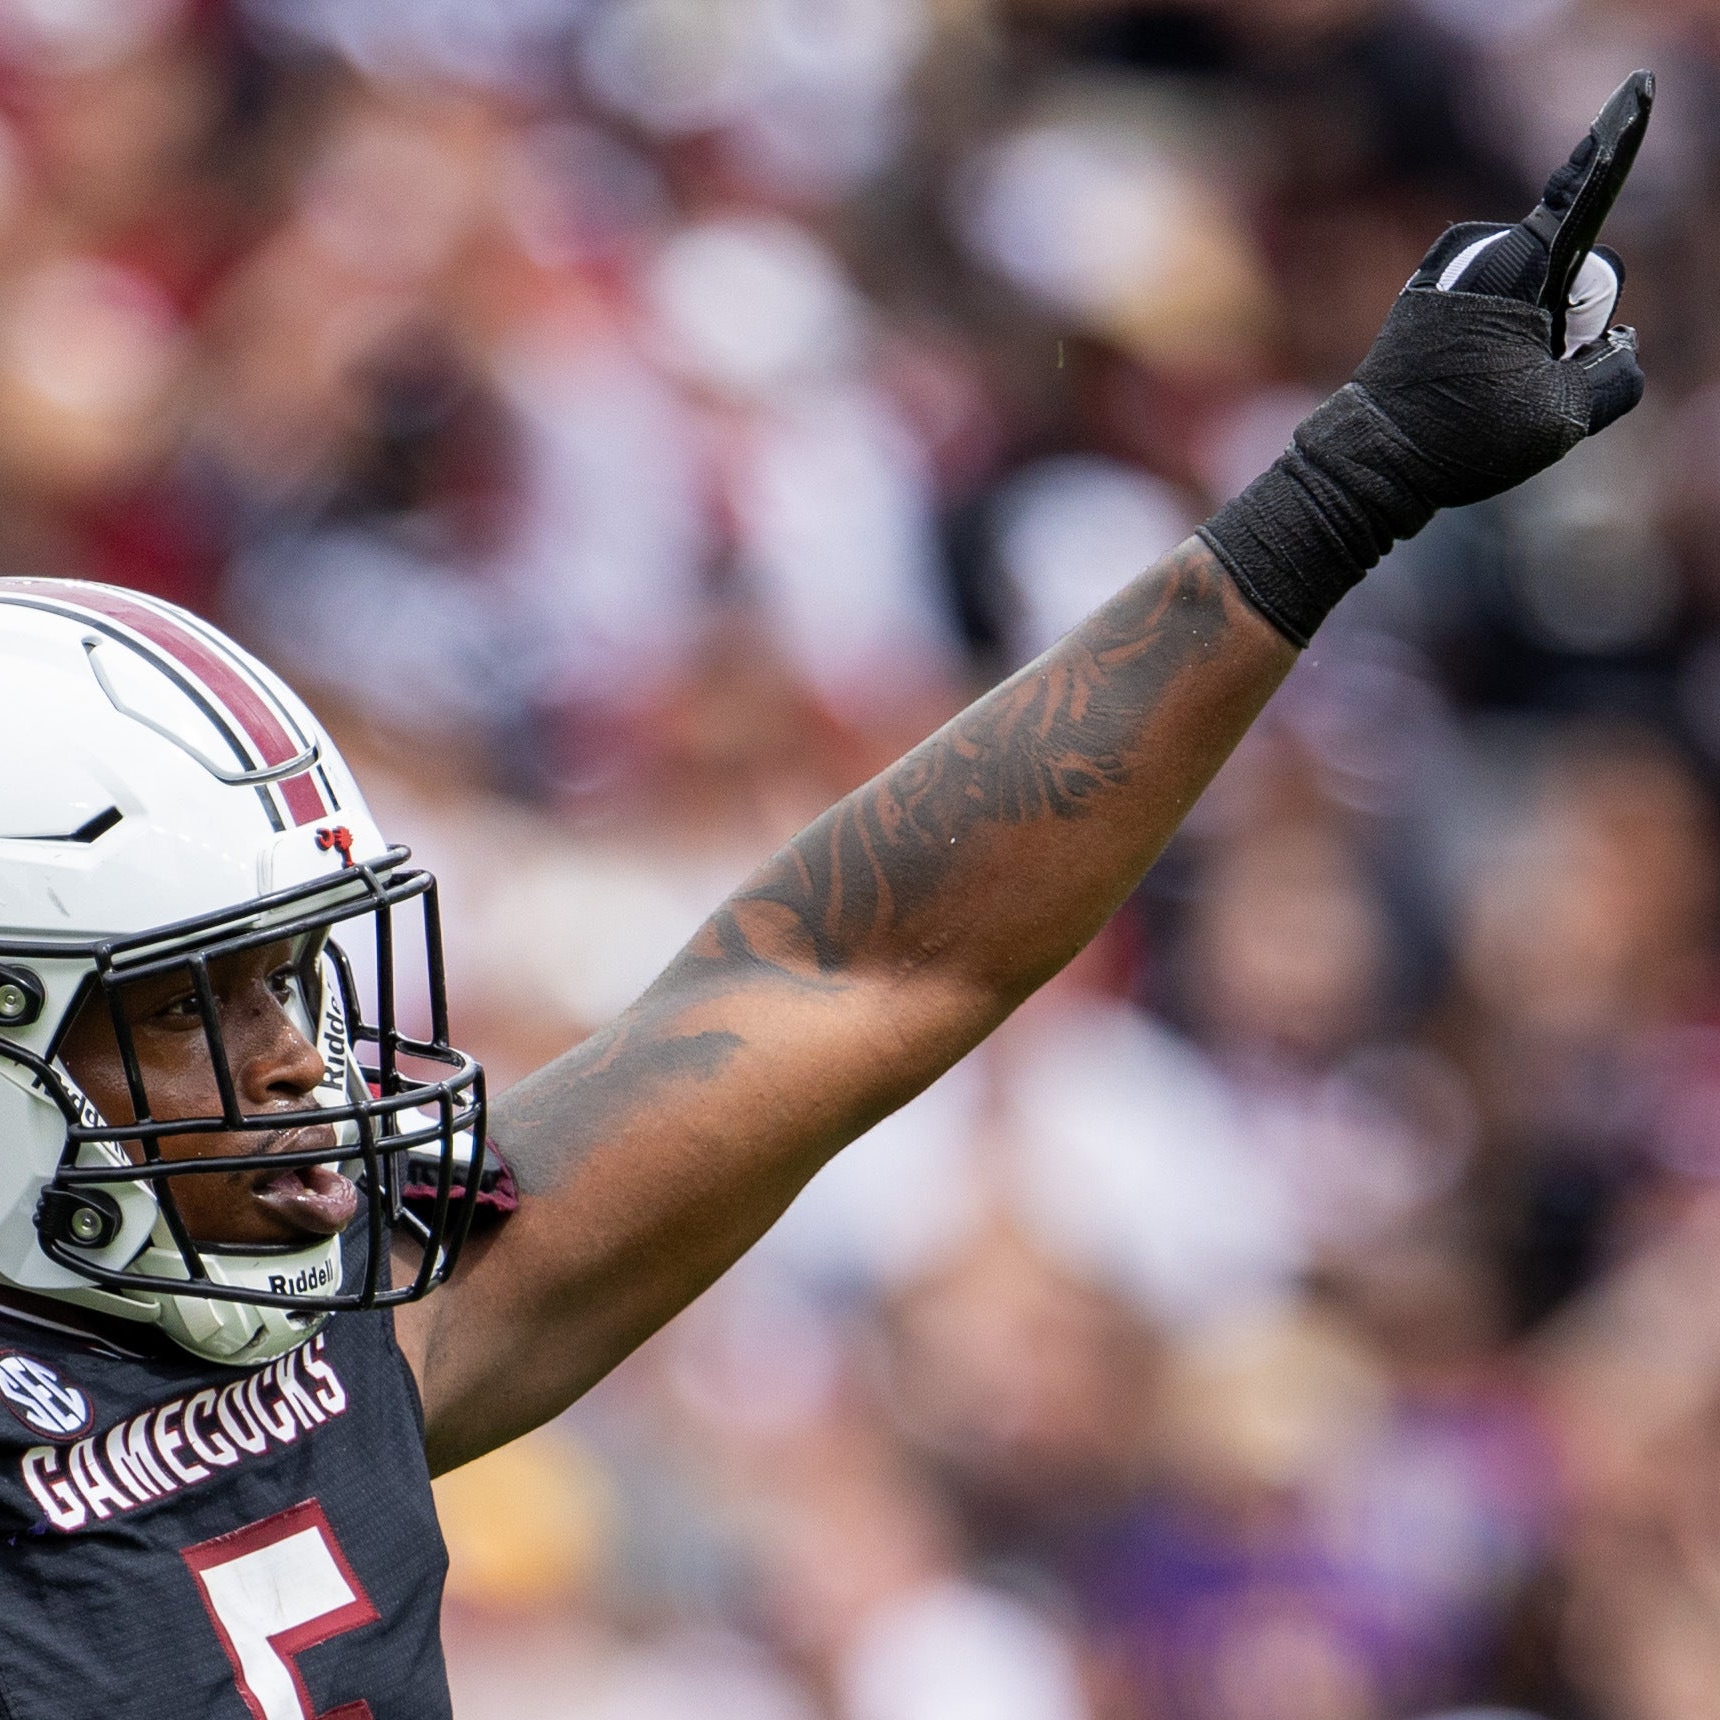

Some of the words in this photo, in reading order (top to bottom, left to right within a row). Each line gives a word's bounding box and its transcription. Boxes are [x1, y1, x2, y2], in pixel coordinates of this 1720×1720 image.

[317, 979, 345, 1092] Ridde
[267, 1258, 333, 1296] Riddell
[21, 1331, 348, 1532] GAMECOCKS
